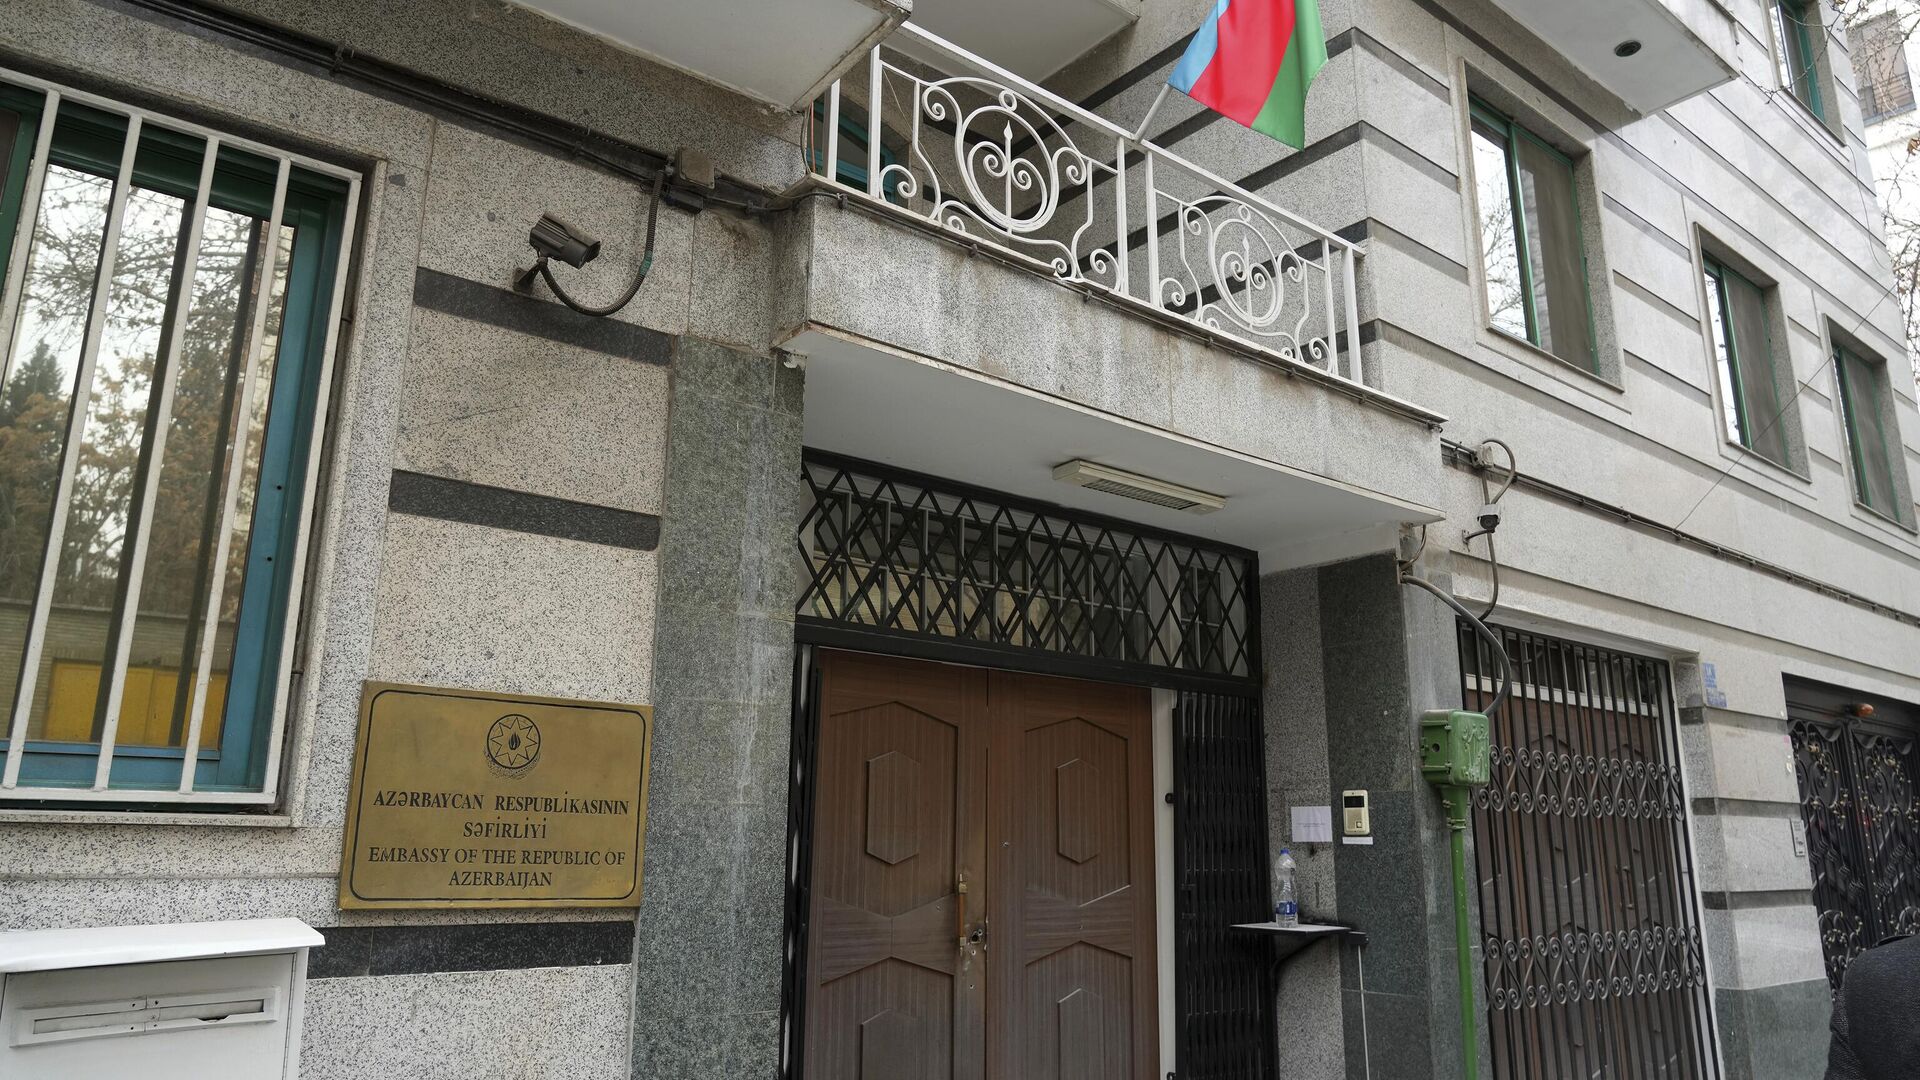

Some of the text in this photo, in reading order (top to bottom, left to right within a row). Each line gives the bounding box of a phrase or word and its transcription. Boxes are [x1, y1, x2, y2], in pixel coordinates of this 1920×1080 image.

[494, 790, 629, 815] RESPUBLİKASININ
[368, 846, 626, 866] EMBASSY OF THE REPUBLIC OF
[448, 870, 552, 889] AZERBAIJAN
